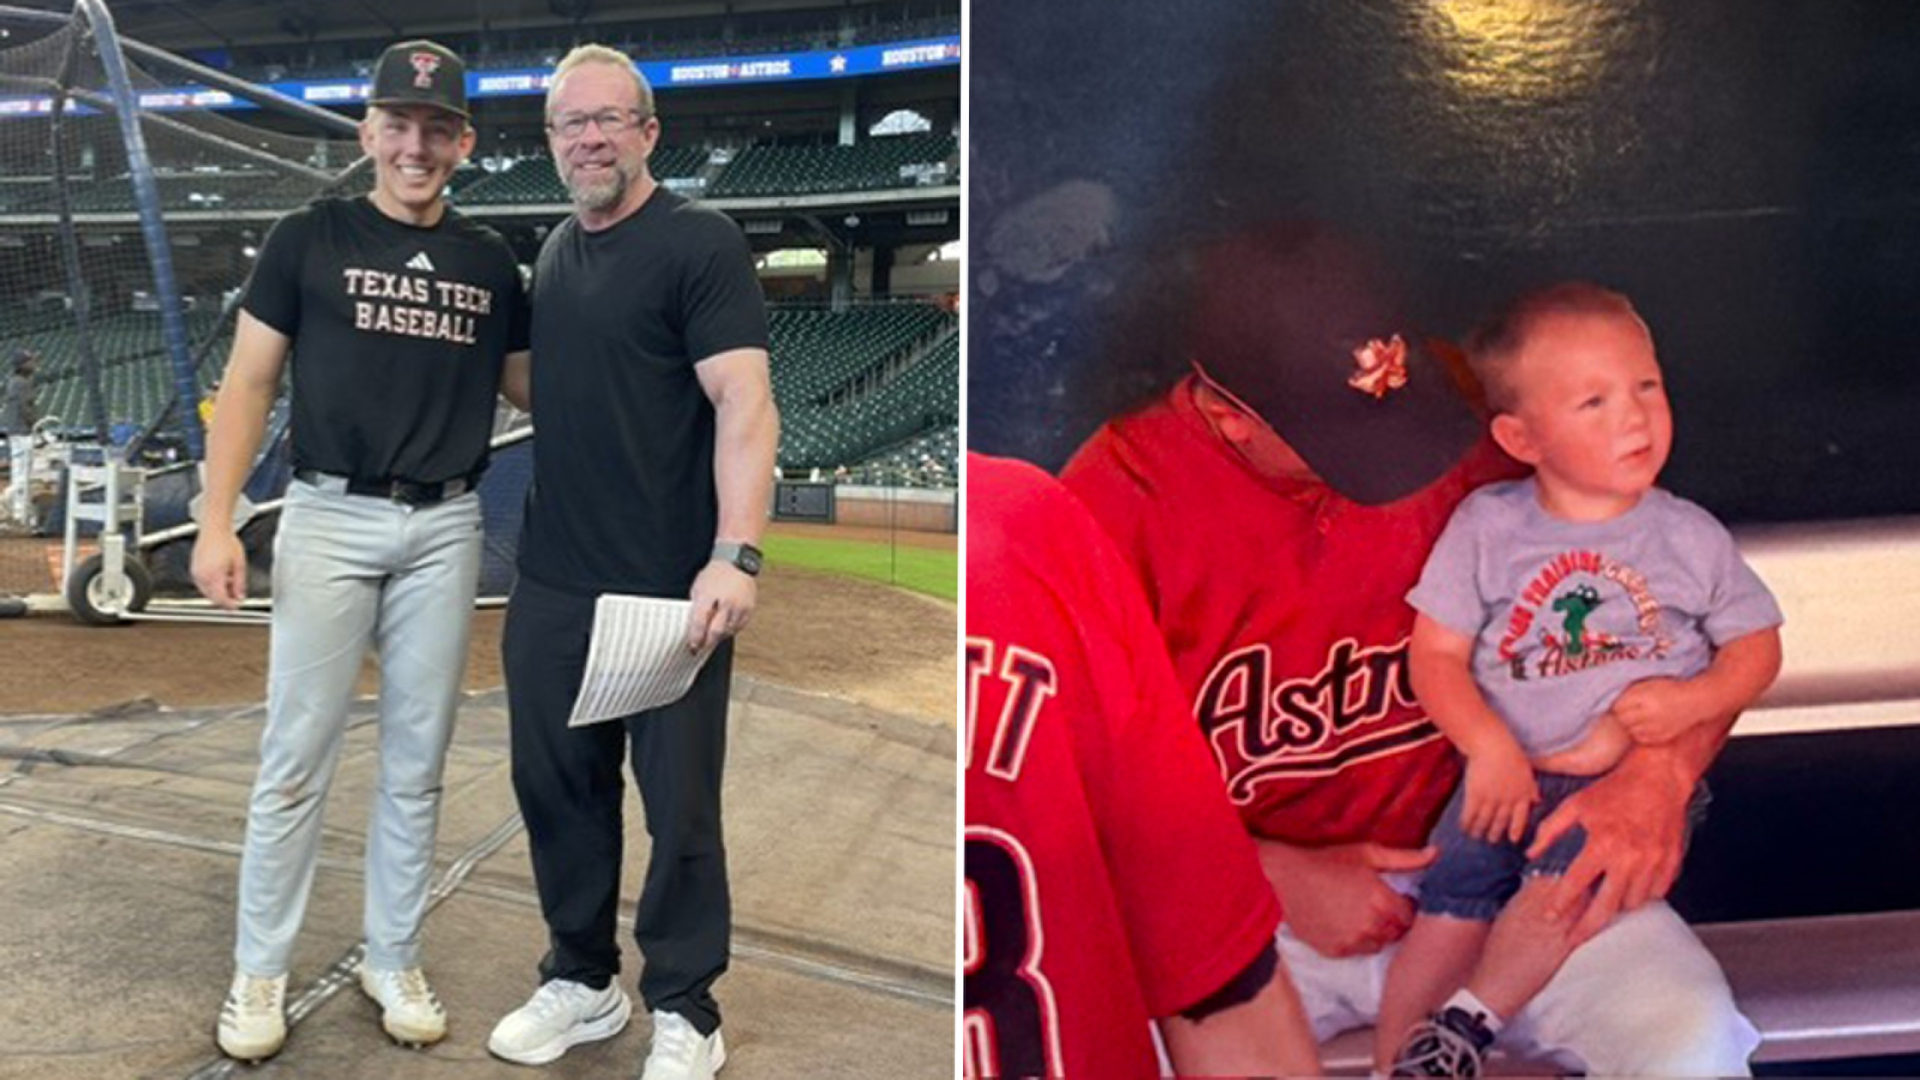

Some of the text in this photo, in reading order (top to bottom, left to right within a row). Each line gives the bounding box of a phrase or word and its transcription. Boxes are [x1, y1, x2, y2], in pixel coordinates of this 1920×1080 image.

[740, 59, 792, 77] ASTROS
[343, 268, 492, 315] TEXAS TECH
[355, 301, 478, 345] BASEBALL
